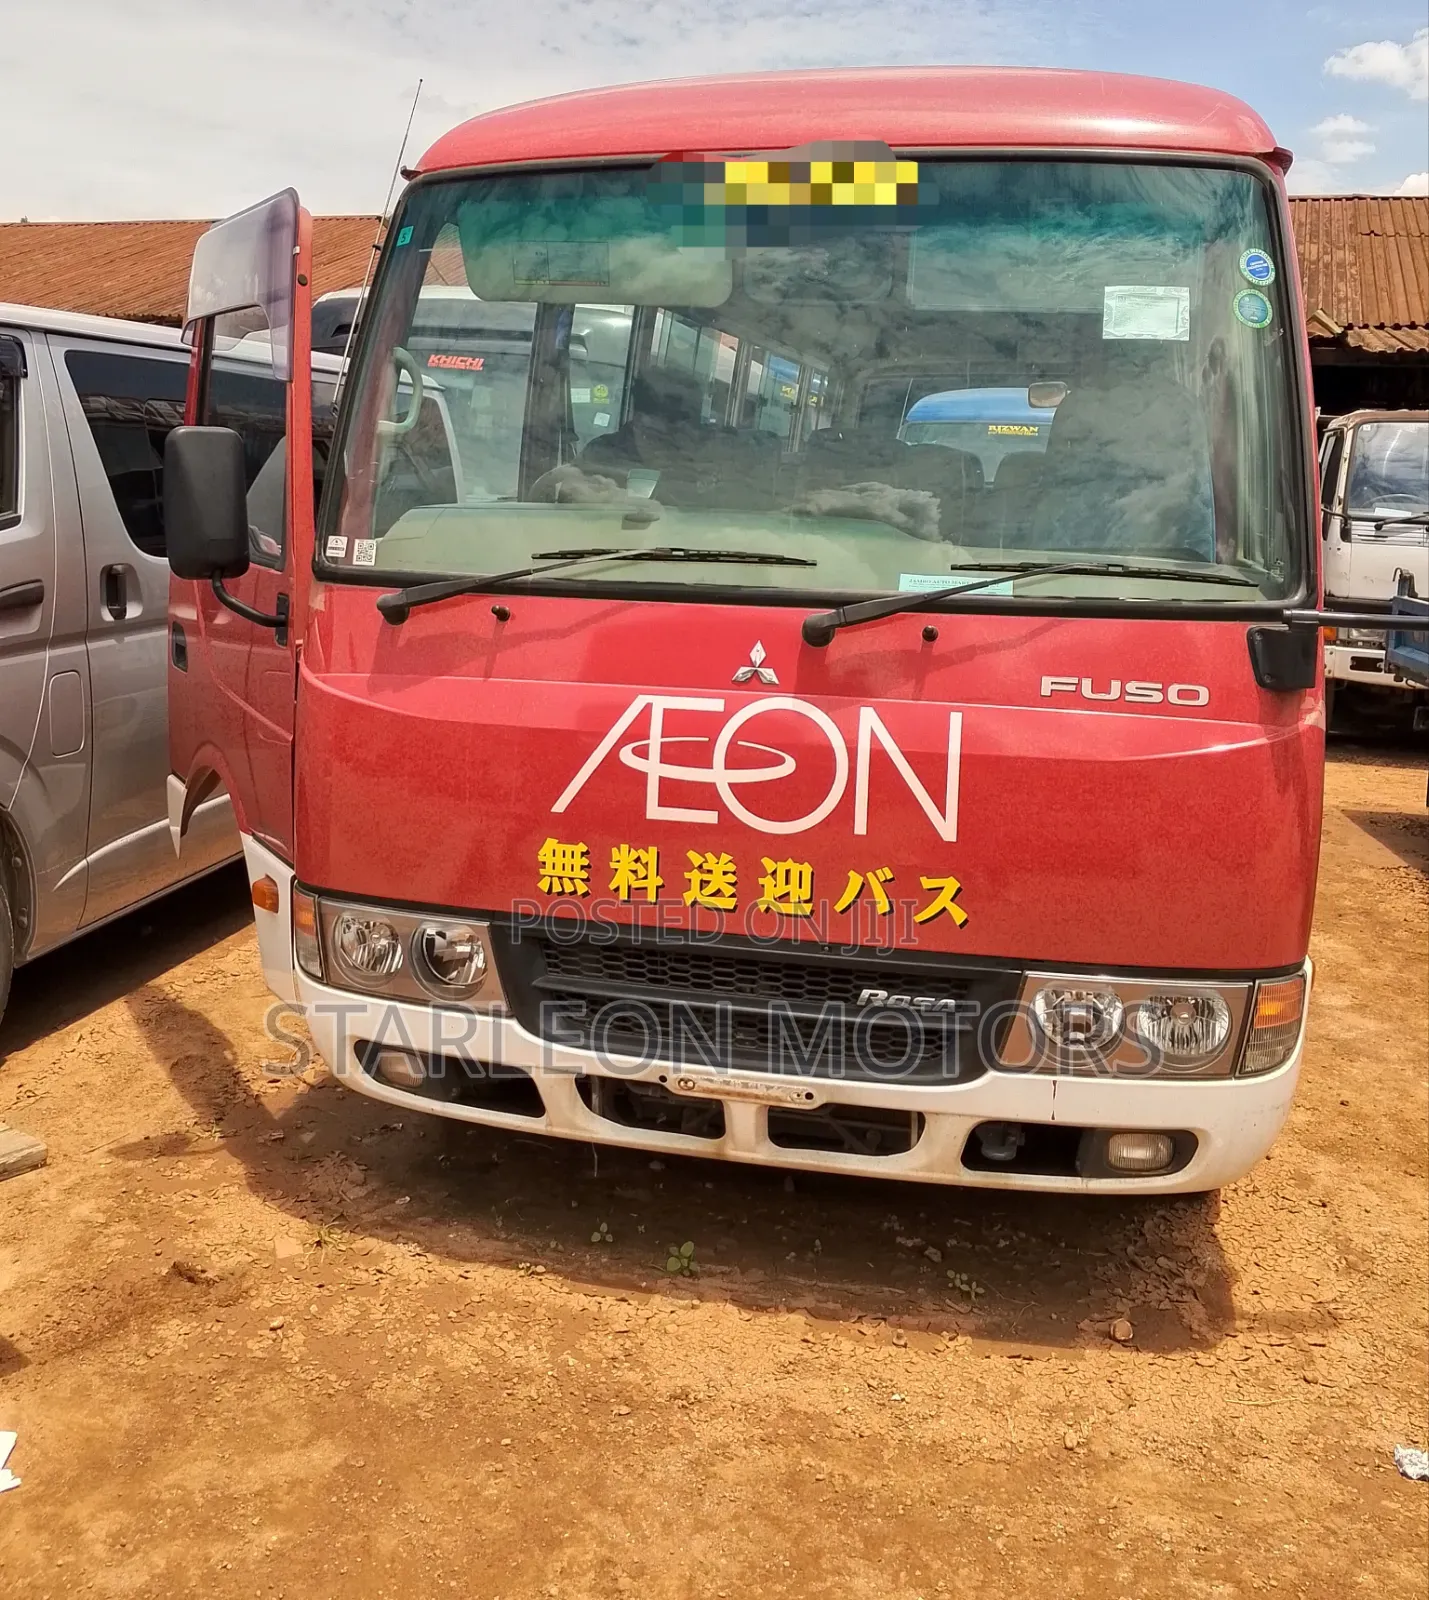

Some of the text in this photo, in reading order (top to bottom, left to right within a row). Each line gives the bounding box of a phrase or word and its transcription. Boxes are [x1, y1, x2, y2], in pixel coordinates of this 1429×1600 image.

[428, 354, 484, 369] KHICHI
[988, 425, 1039, 433] RIZWAN
[1040, 675, 1210, 707] FUSO
[537, 837, 970, 928] 無料送迎バス
